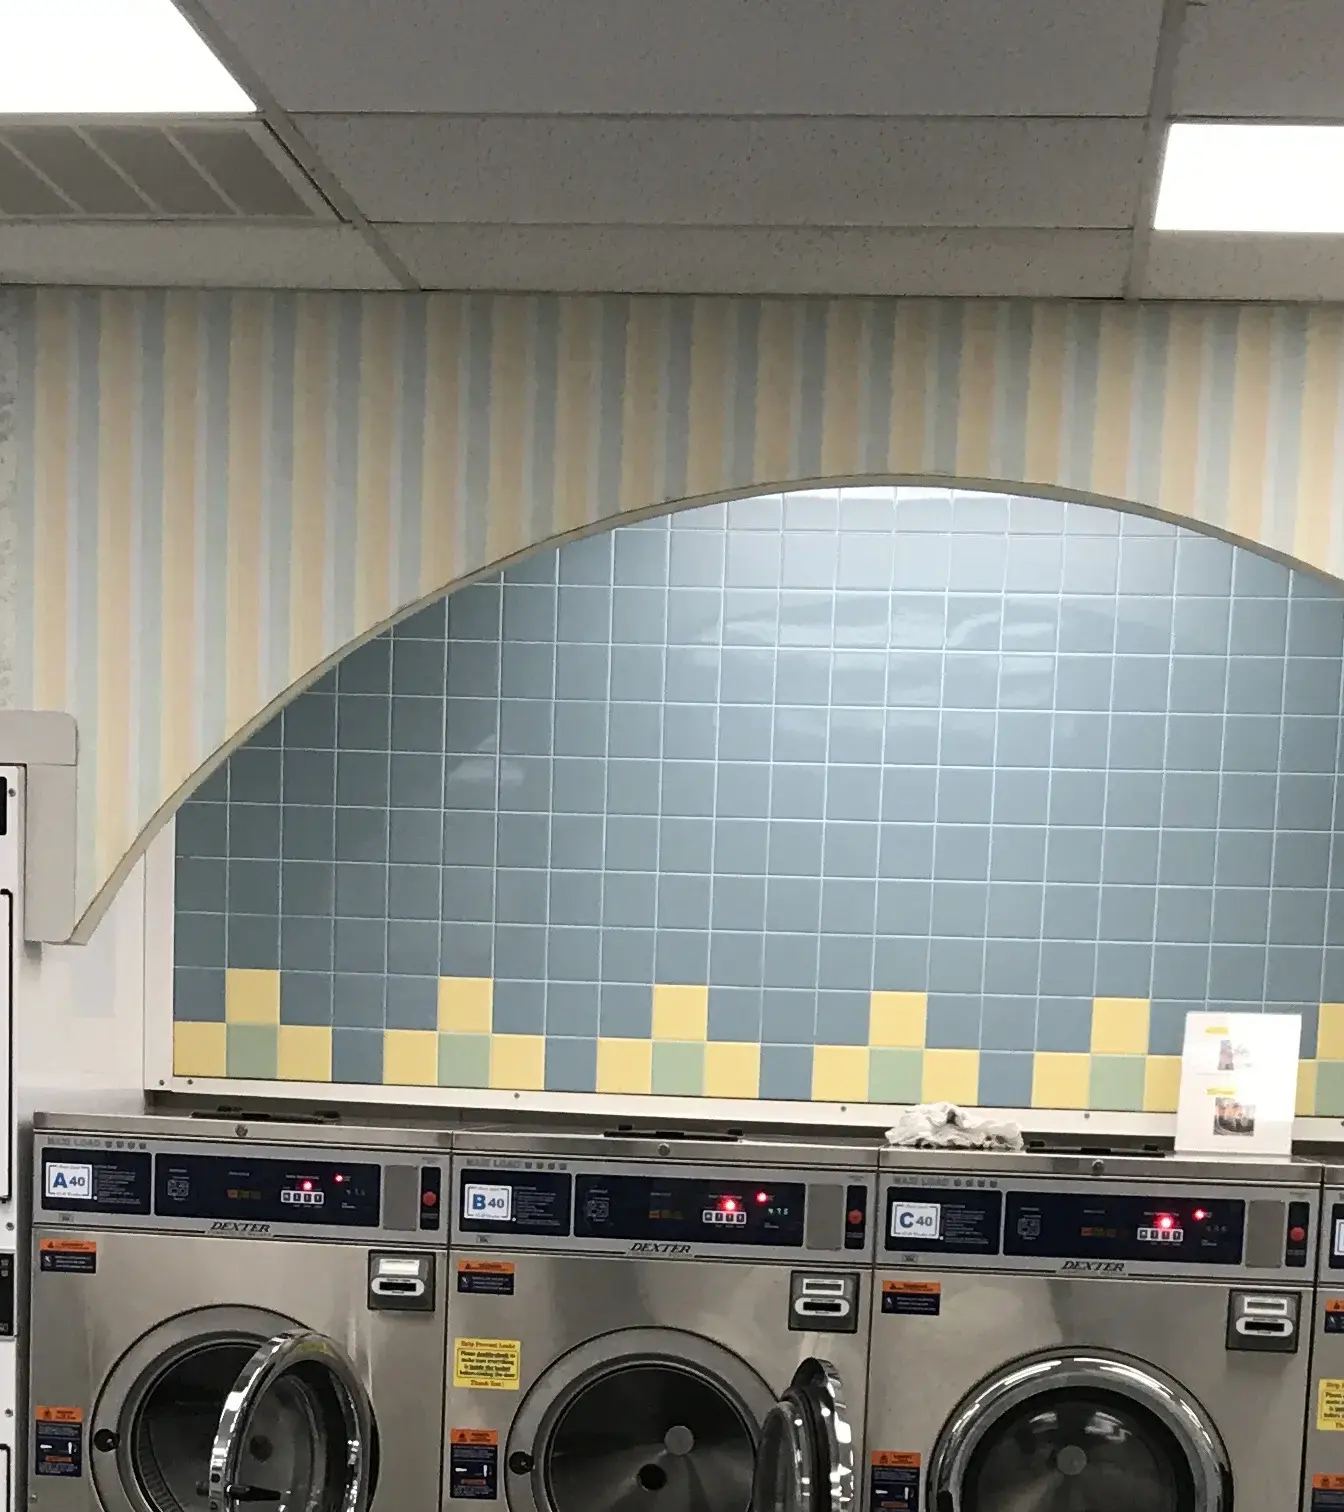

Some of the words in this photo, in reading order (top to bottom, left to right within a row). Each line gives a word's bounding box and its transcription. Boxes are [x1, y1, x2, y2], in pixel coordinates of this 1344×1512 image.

[52, 1172, 68, 1188] A
[69, 1176, 86, 1187] 40
[472, 1194, 487, 1209] B
[488, 1198, 505, 1208] 40
[210, 1221, 271, 1232] DEXTER
[899, 1212, 914, 1228] C
[916, 1216, 933, 1227] 40
[630, 1242, 692, 1253] DEXTER
[1061, 1260, 1125, 1272] DEXTER
